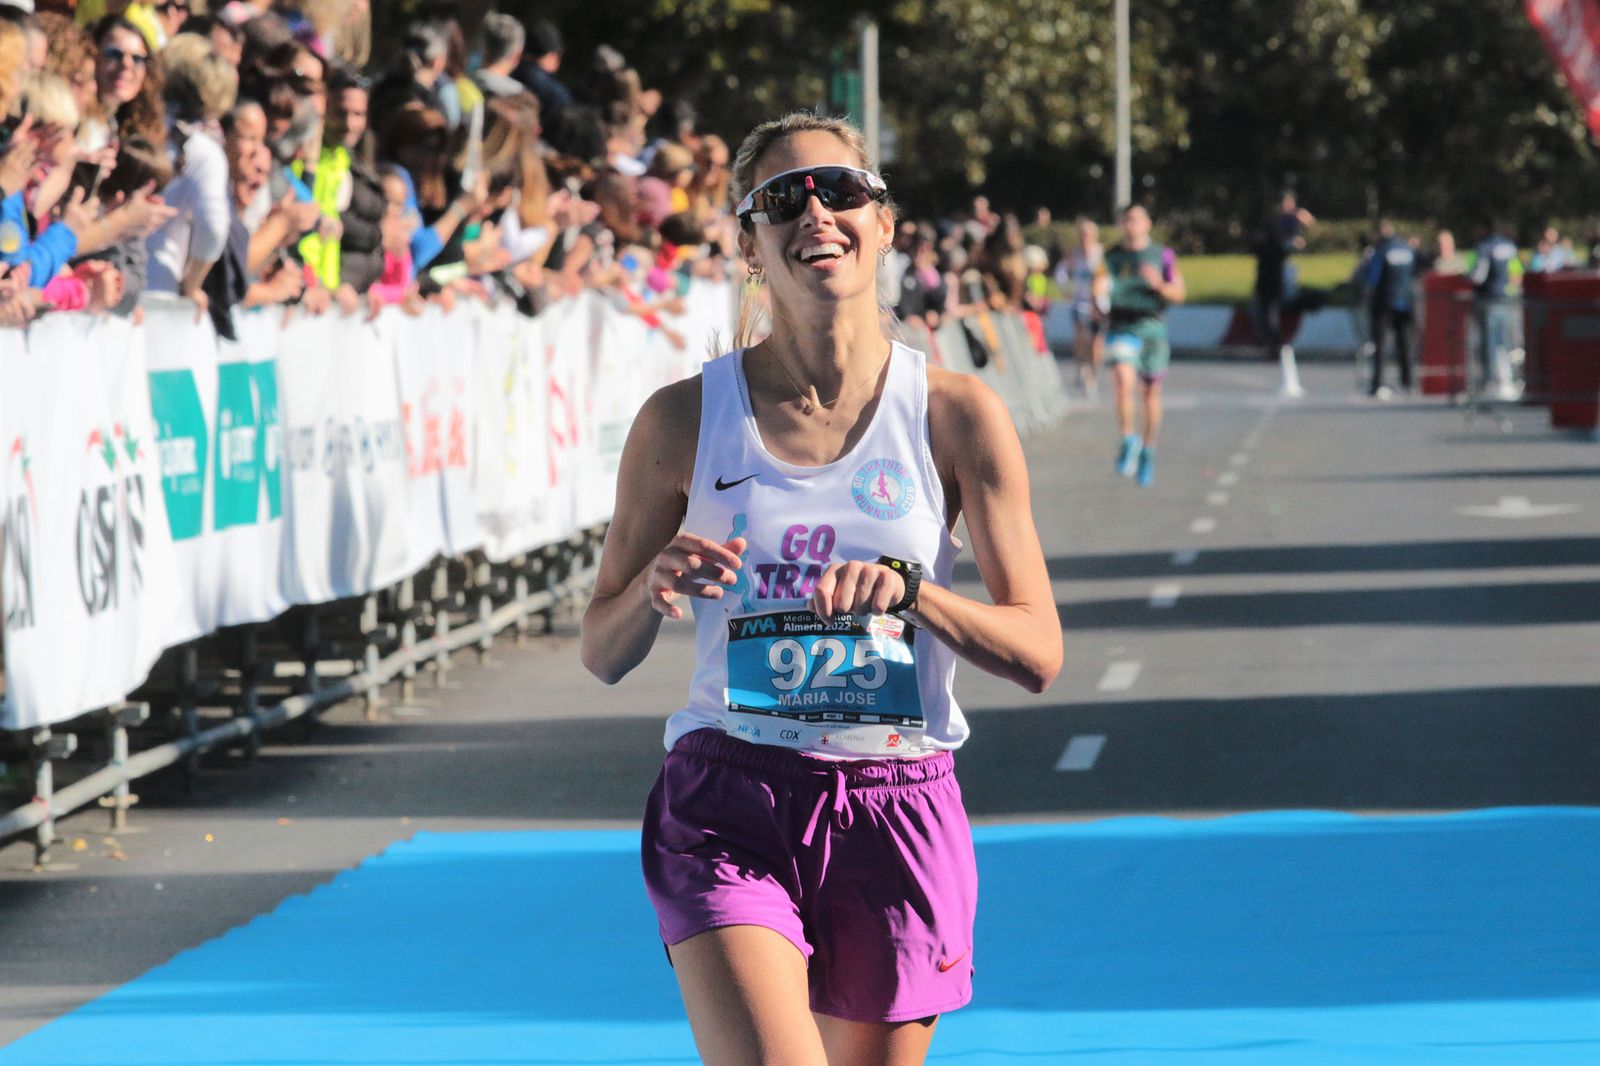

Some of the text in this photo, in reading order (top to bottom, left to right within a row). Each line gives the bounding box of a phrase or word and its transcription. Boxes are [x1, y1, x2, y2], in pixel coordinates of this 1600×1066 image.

[854, 494, 902, 520] RUNNING
[755, 563, 822, 600] TRA
[783, 614, 811, 623] Medio
[824, 621, 852, 632] 2022
[768, 637, 888, 692] 925
[778, 690, 877, 706] MARIA JOSE
[780, 728, 802, 741] CDX
